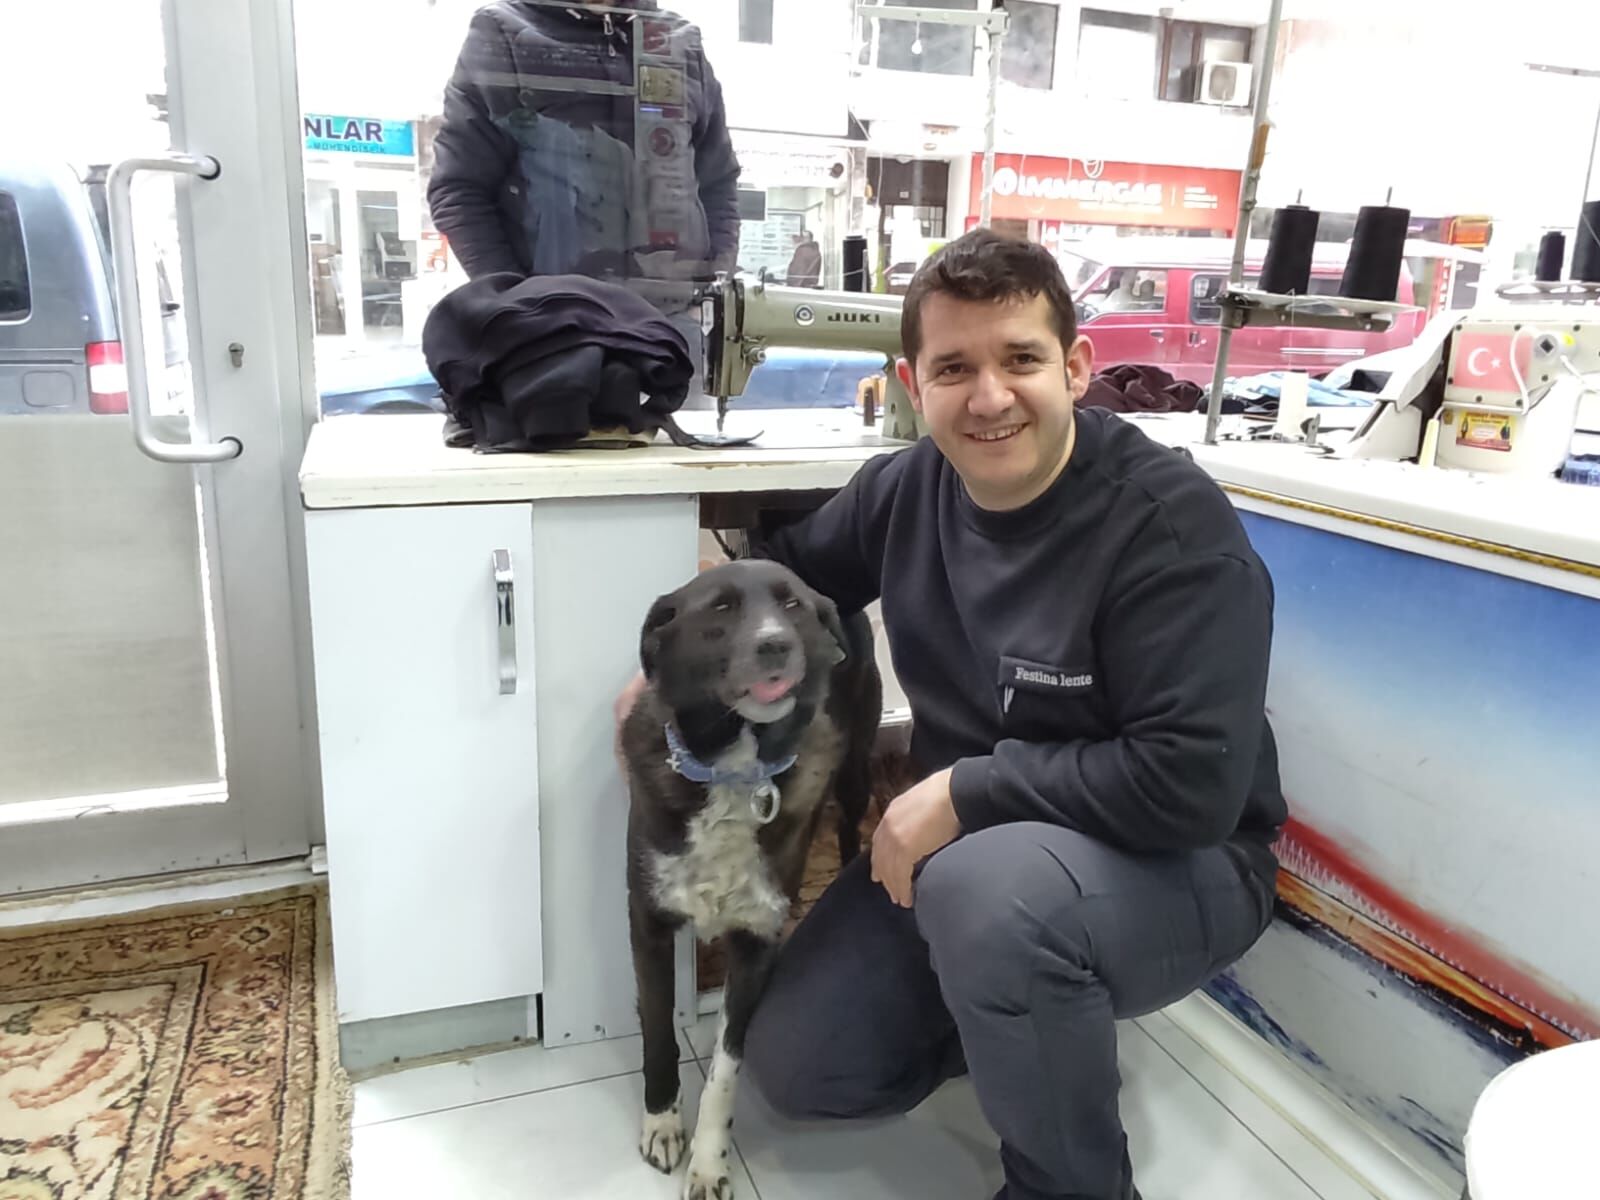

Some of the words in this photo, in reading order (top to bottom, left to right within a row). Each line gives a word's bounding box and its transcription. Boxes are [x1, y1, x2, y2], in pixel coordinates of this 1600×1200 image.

[303, 117, 384, 143] NLAR
[827, 312, 880, 323] JUKI
[1015, 666, 1058, 685] Festina
[1060, 673, 1093, 687] lente
